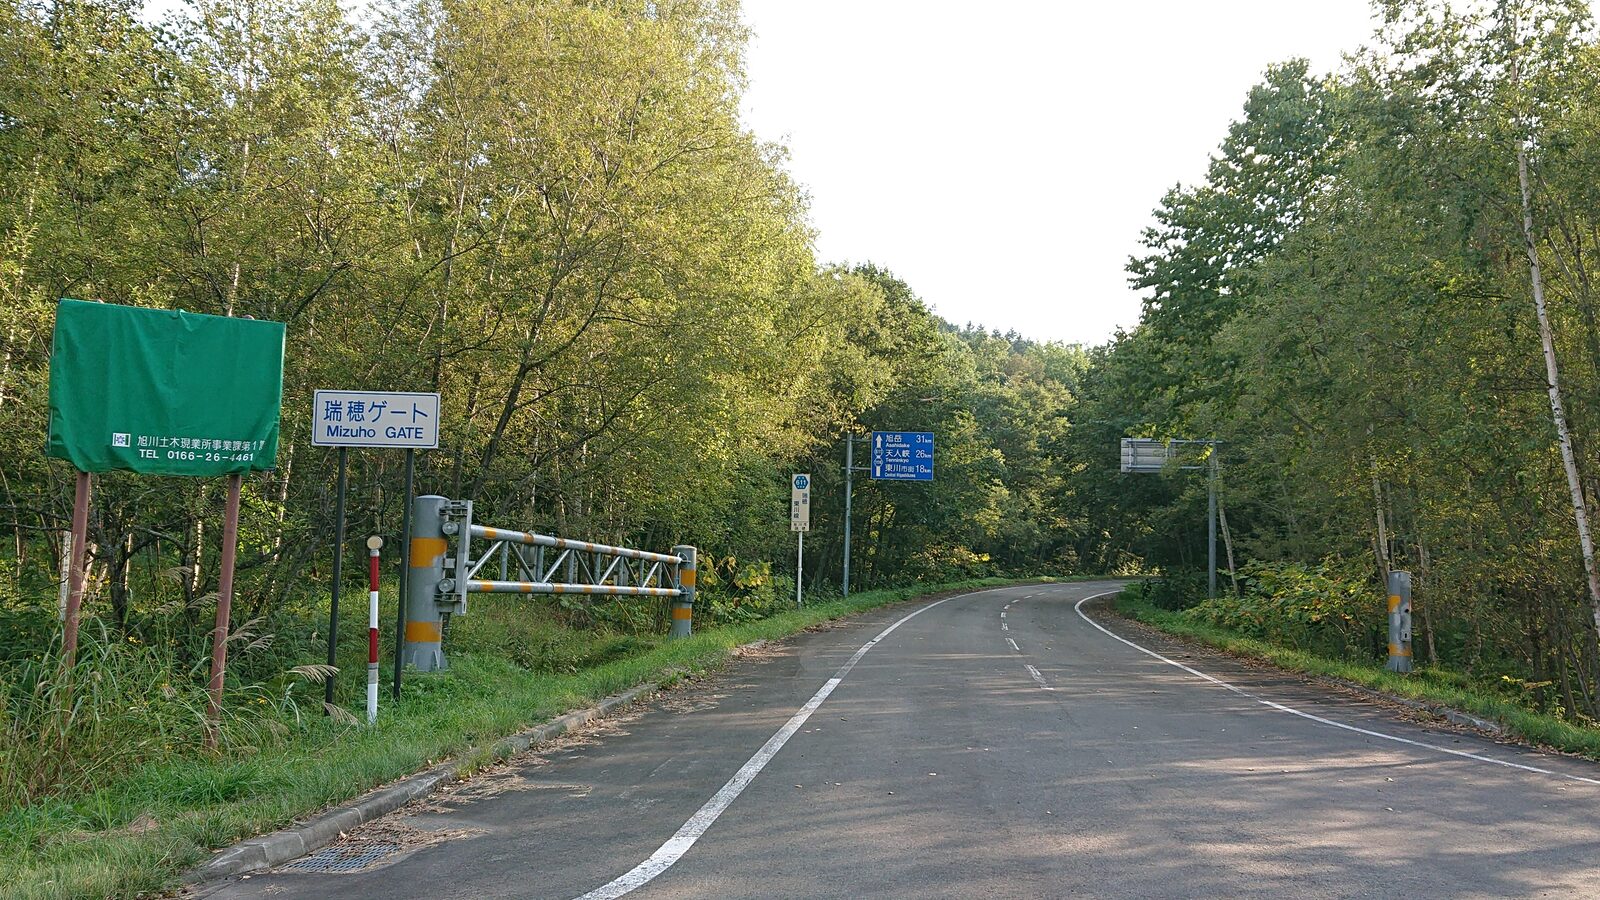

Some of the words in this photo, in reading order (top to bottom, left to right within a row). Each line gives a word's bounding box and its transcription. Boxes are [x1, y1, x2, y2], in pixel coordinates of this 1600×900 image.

[323, 400, 428, 423] 瑞穂ゲート
[326, 425, 376, 438] Mizuho
[385, 426, 424, 439] GATE
[885, 434, 902, 443] 旭岳
[139, 449, 159, 459] TEL
